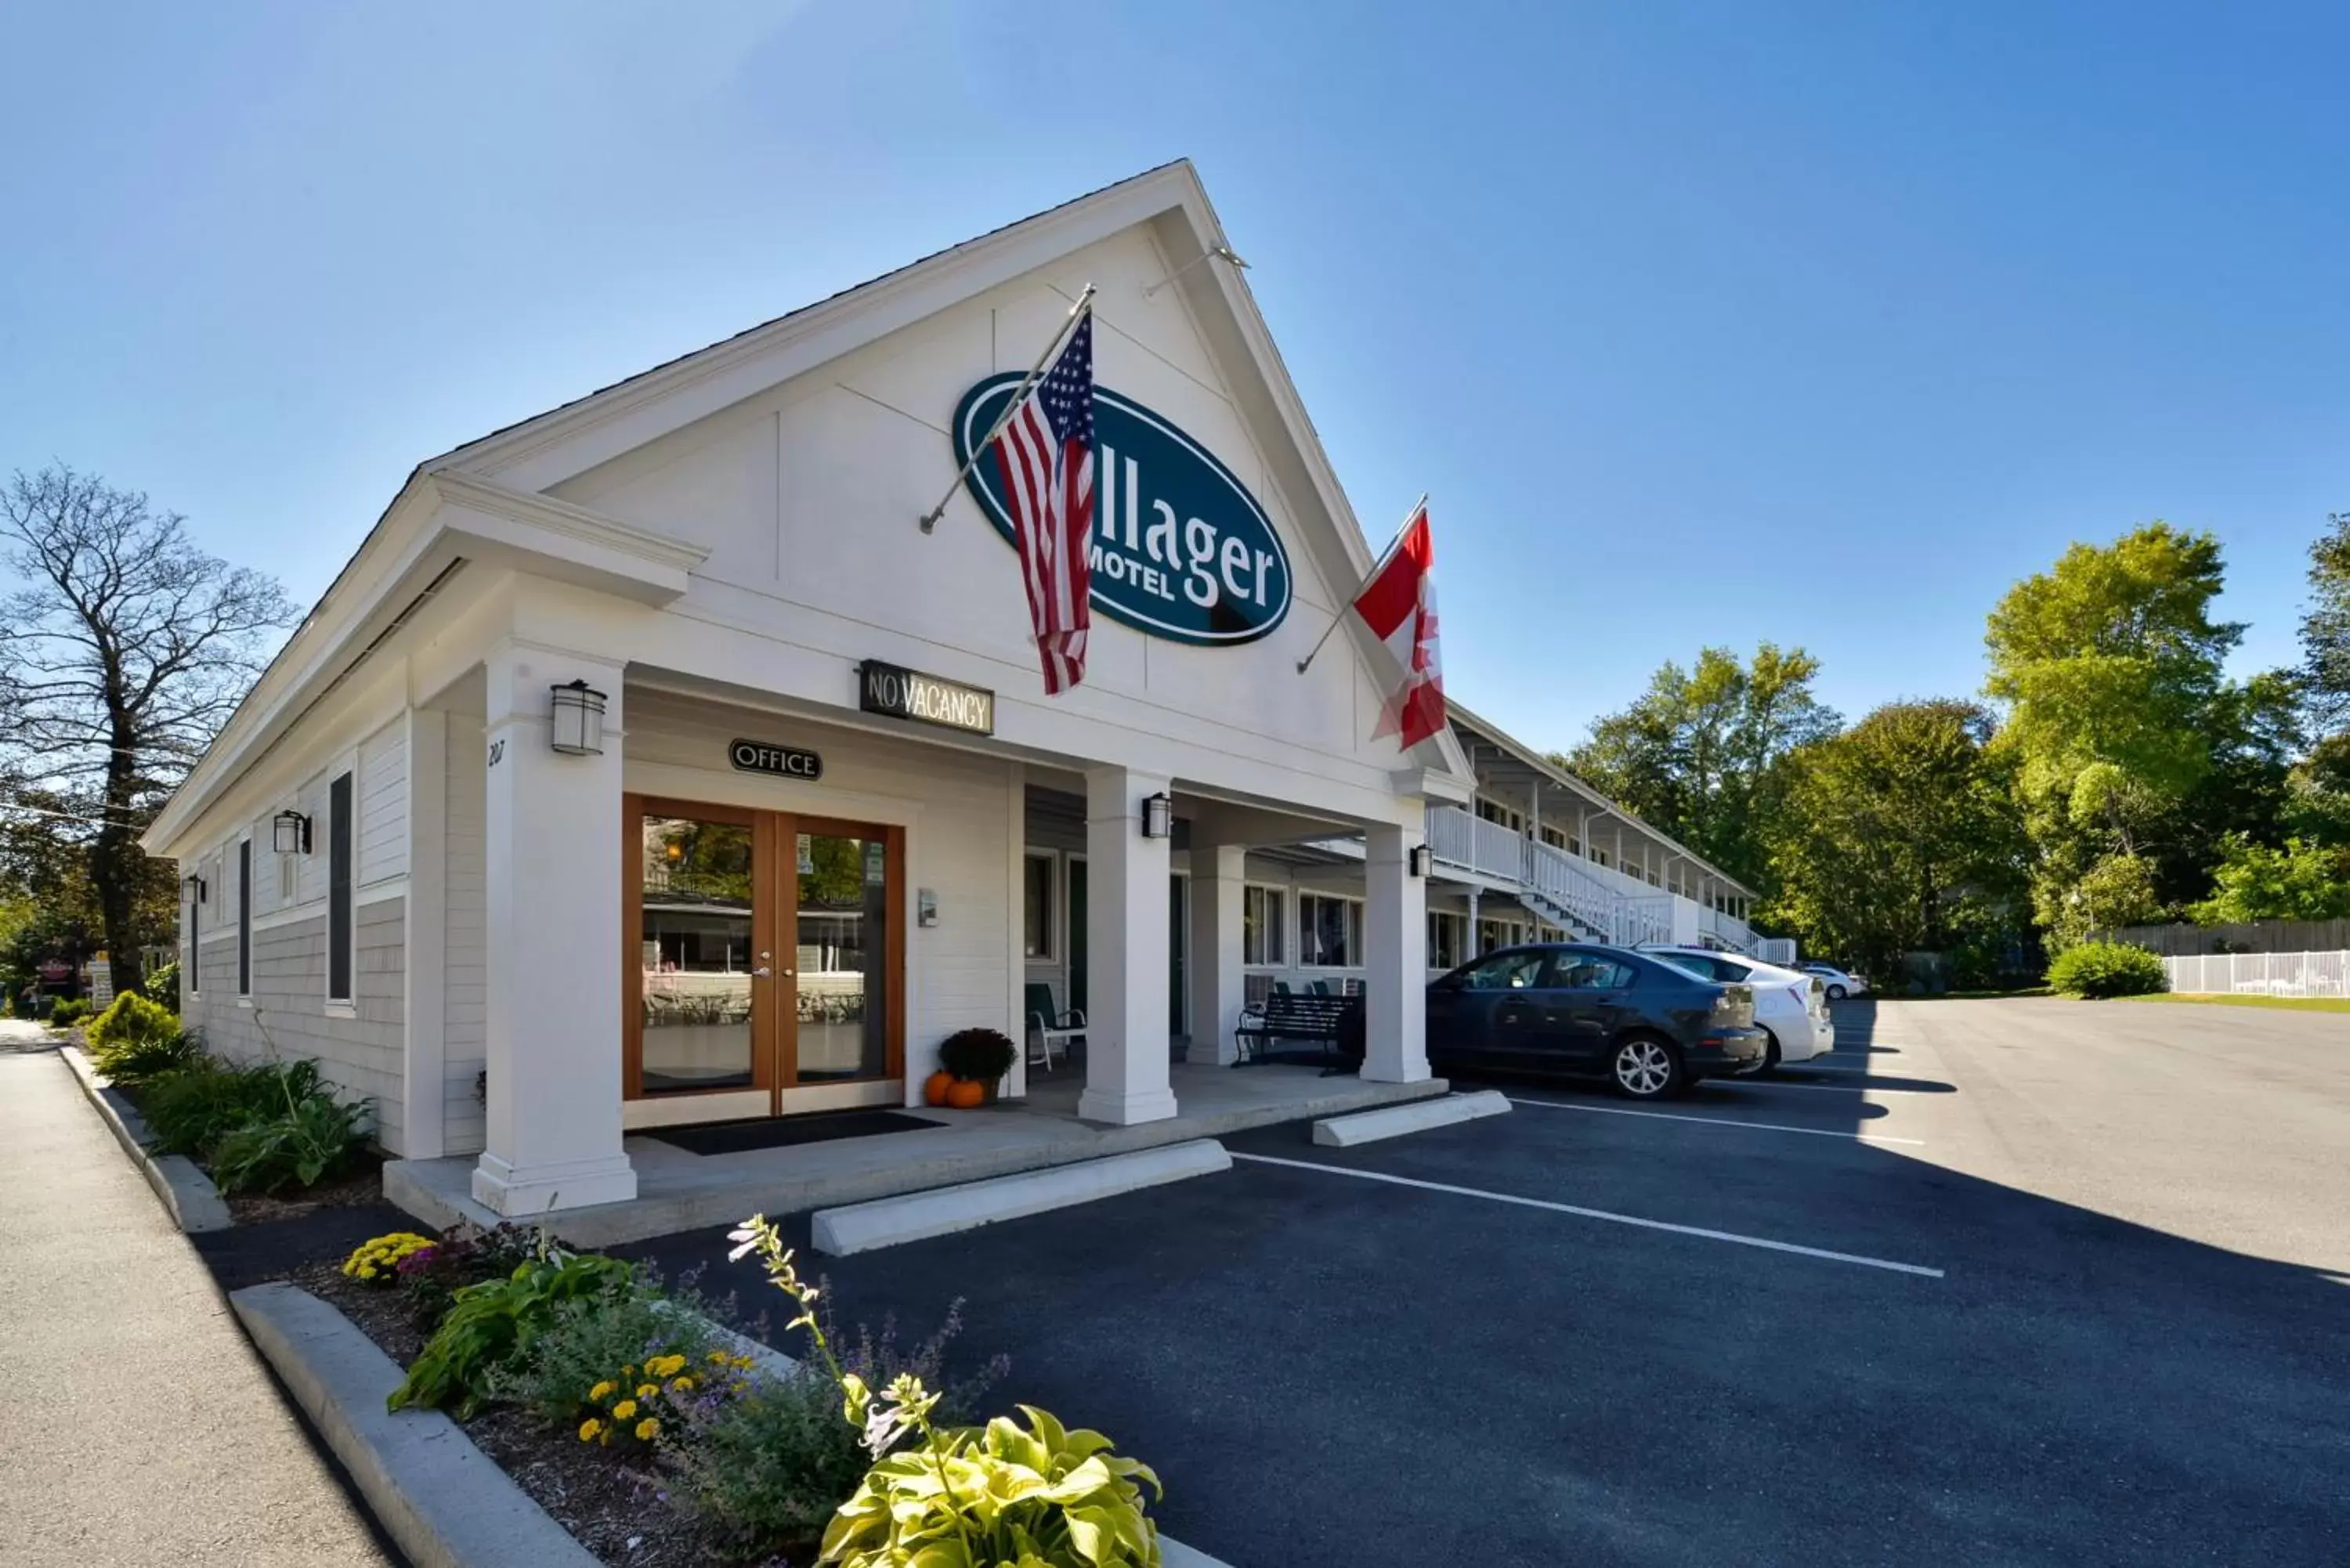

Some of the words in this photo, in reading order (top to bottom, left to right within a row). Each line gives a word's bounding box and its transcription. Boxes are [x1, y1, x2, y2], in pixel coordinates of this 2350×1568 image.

[1101, 443, 1274, 608] llager
[869, 669, 898, 708] NO
[902, 672, 986, 729] VACANCY
[736, 745, 815, 775] OFFICE
